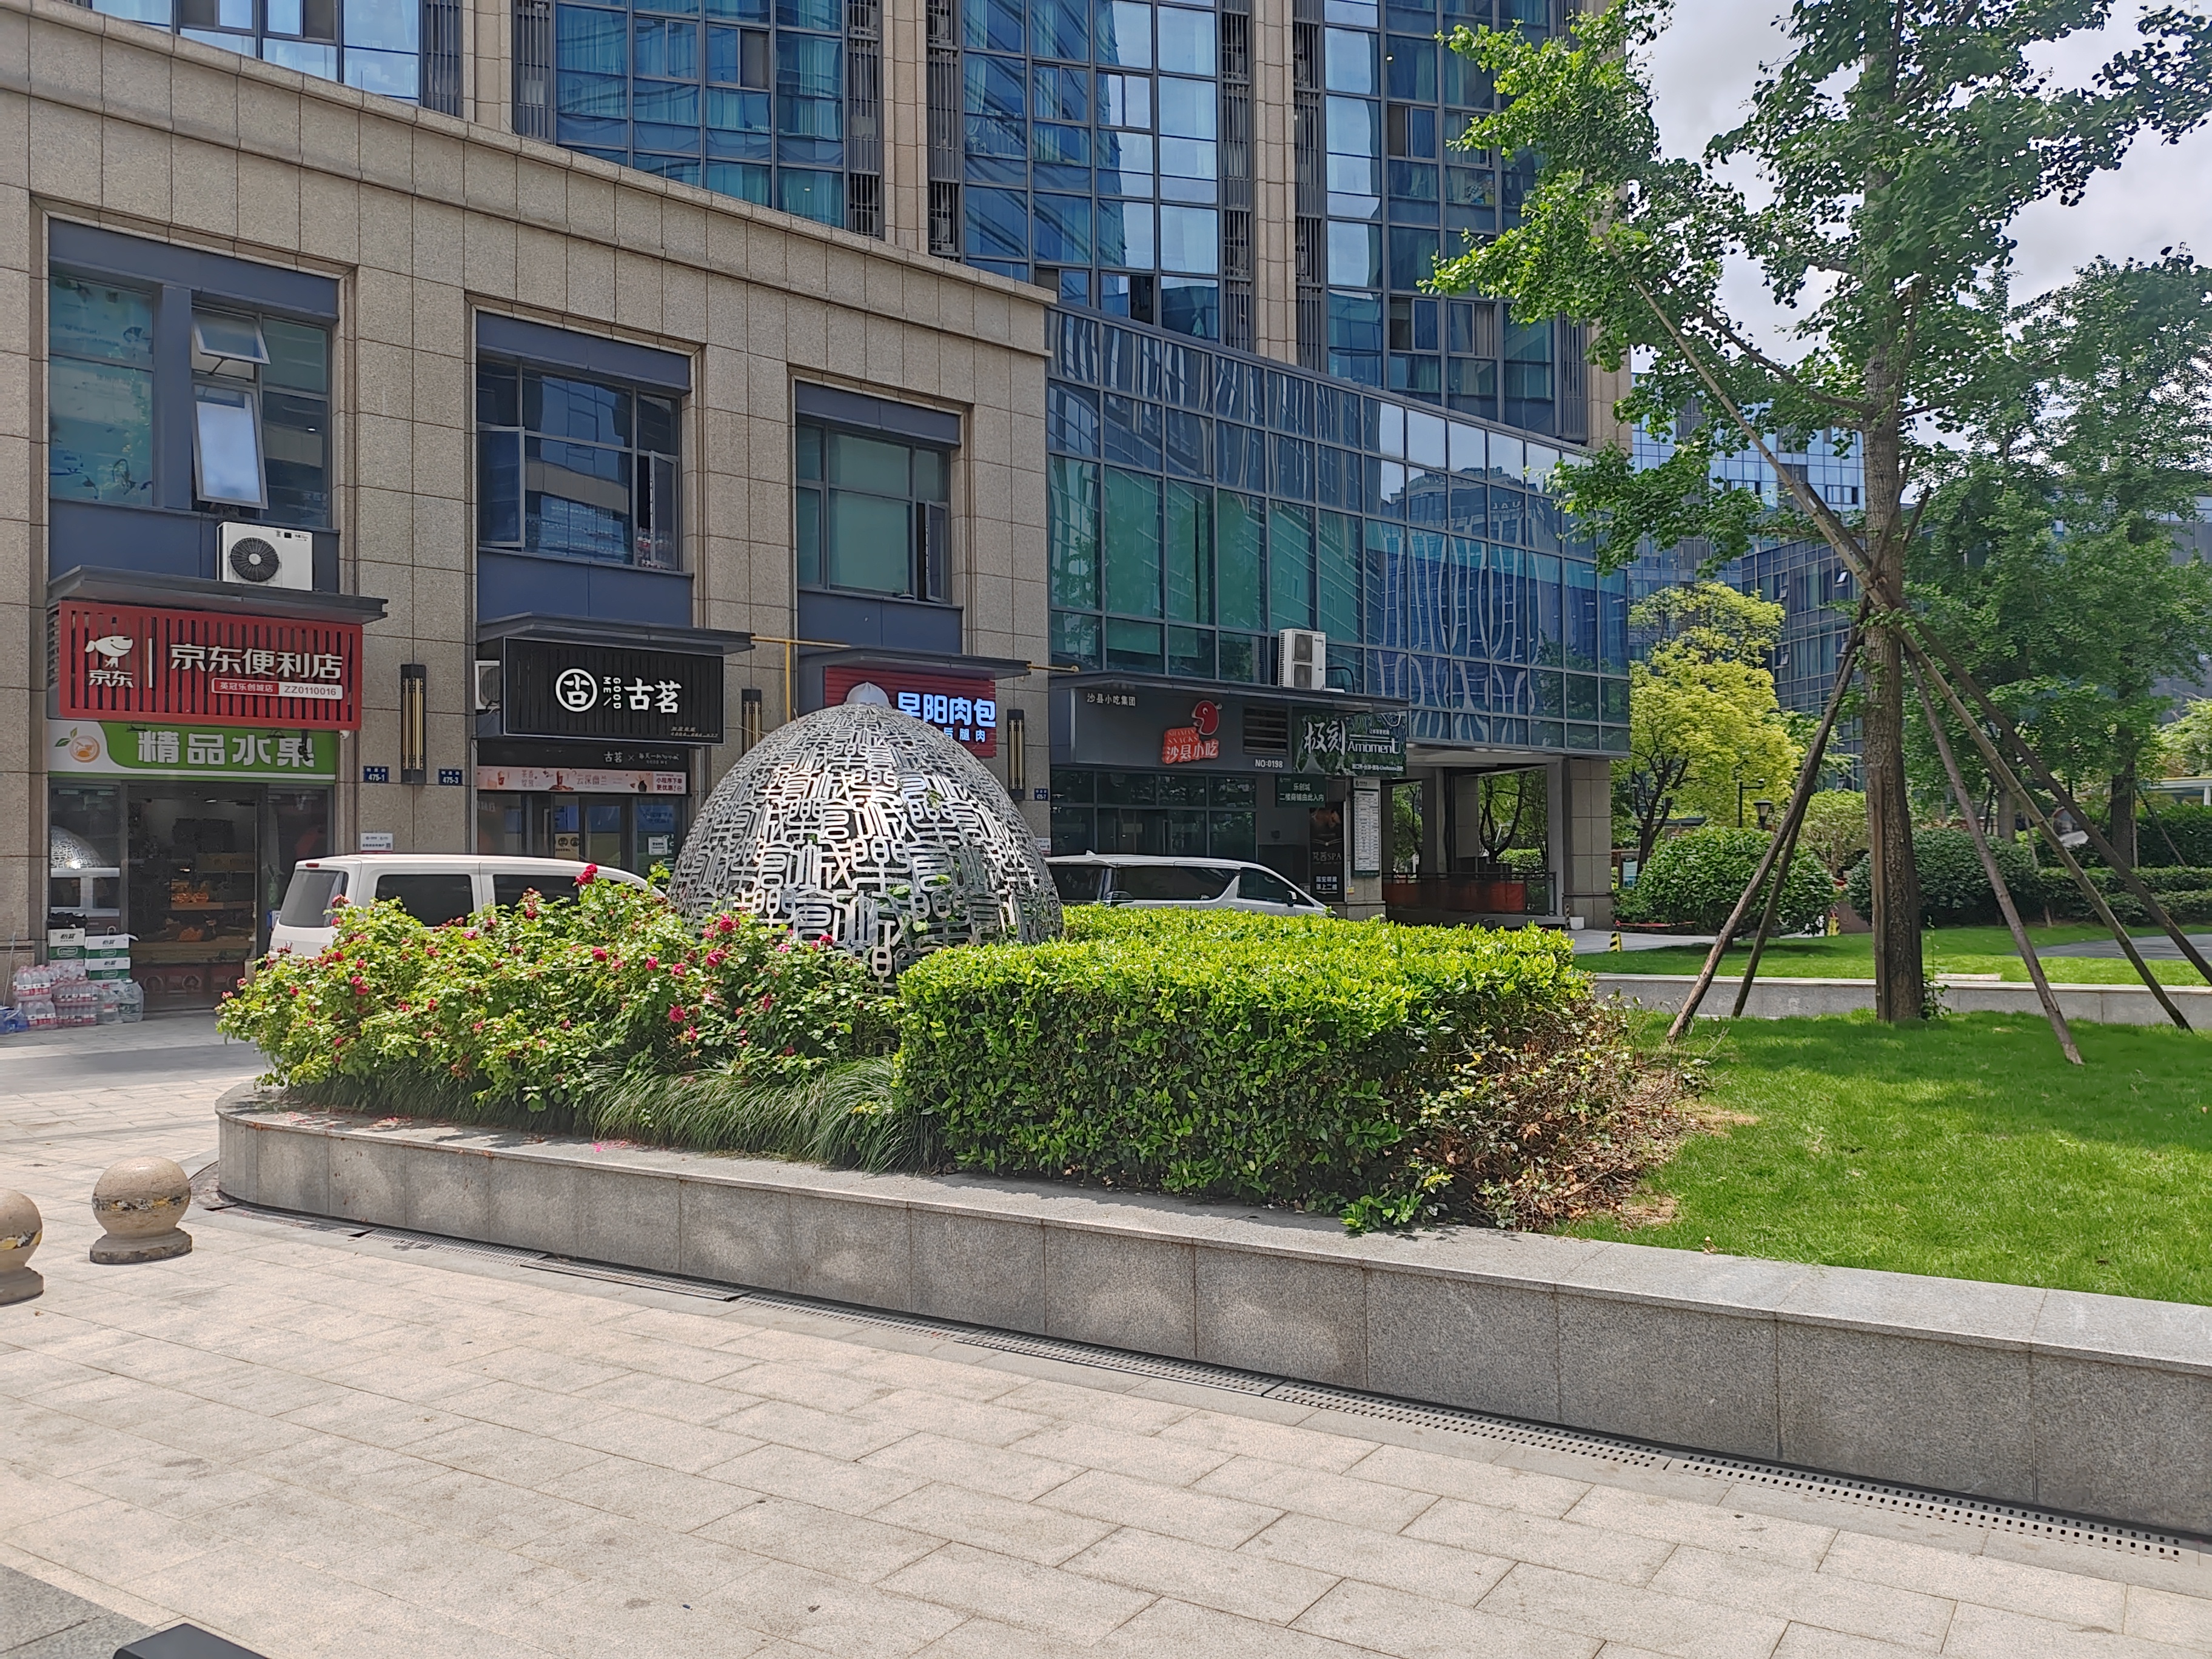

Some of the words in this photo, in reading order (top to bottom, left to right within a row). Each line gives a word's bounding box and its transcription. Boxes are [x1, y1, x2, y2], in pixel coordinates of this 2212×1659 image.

[170, 643, 343, 679] 京东便利店
[89, 669, 134, 688] 京东
[284, 686, 336, 695] ZZ0110016
[624, 677, 682, 713] 古茗
[1087, 693, 1136, 706] 沙县小吃集团
[898, 692, 996, 727] 早阳肉包
[138, 731, 314, 767] 精品水果
[1167, 741, 1218, 760] 沙县小吃
[1304, 720, 1346, 756] 极刻
[1255, 759, 1283, 768] NO:0198
